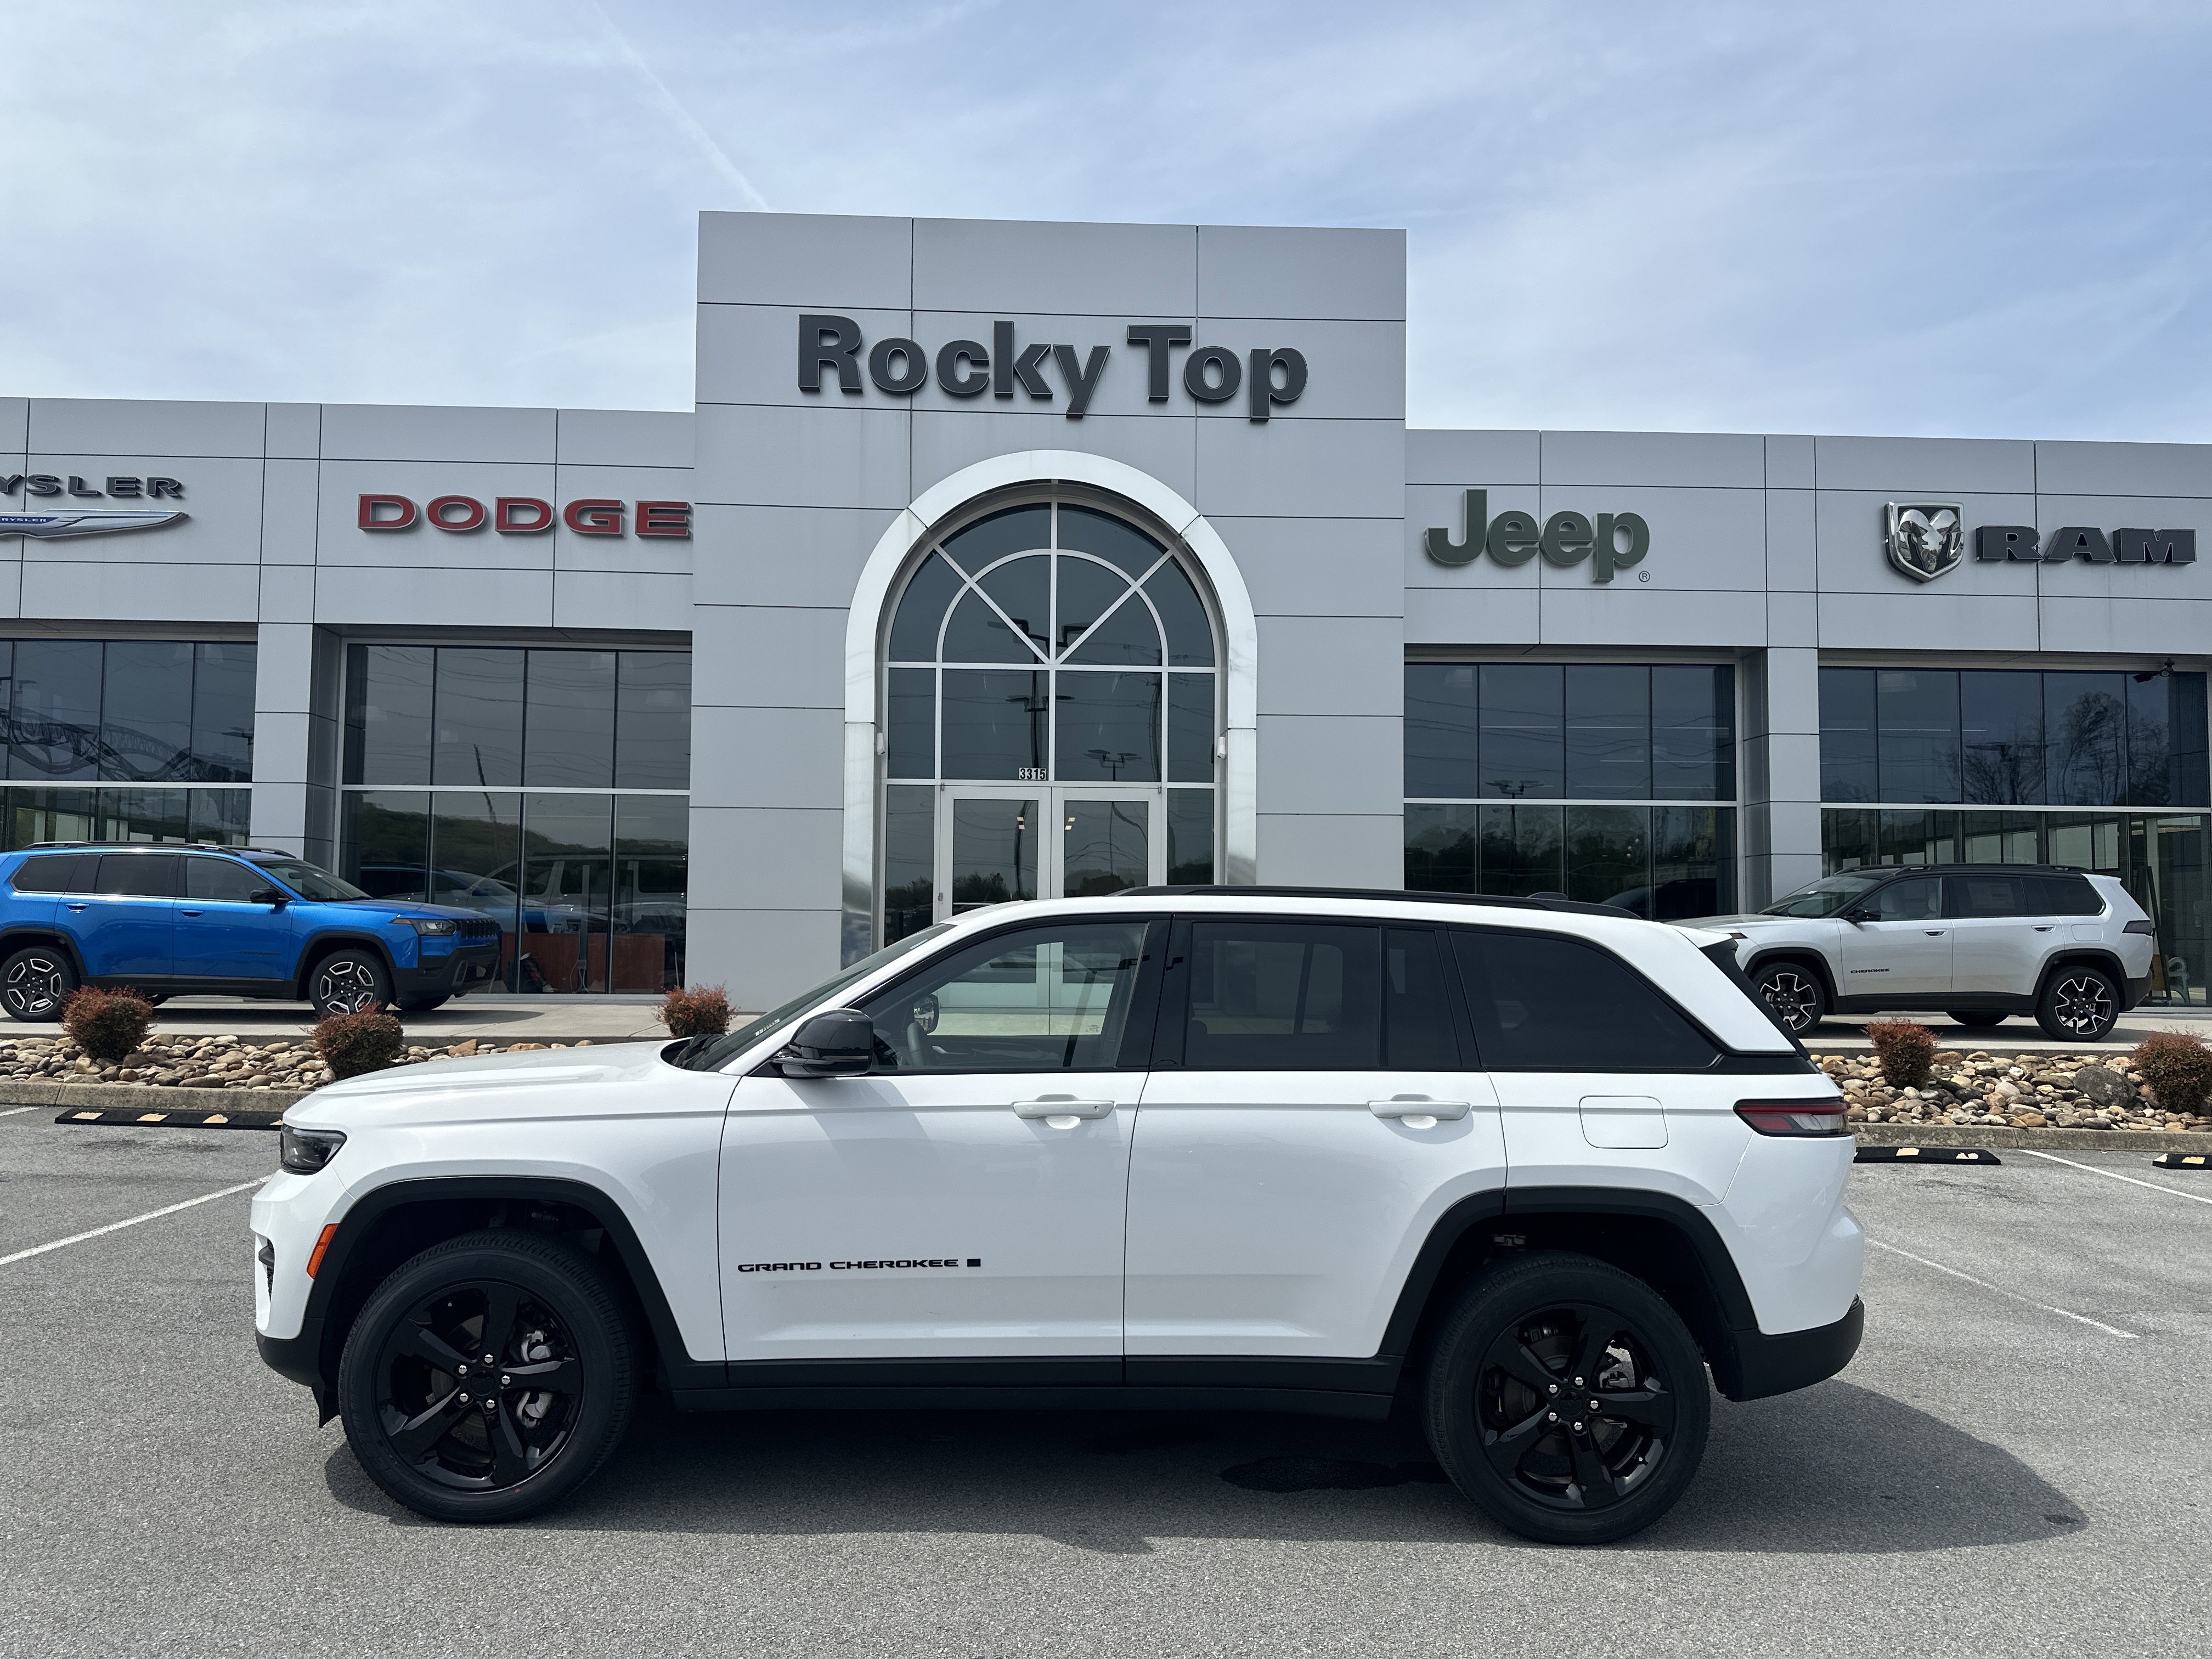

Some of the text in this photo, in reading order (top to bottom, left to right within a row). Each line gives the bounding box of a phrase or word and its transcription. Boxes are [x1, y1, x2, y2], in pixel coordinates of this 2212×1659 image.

[798, 314, 1308, 422] Rocky Top
[358, 494, 693, 539] DODGE
[1425, 489, 1650, 583] Jeep
[1976, 525, 2197, 566] RAM
[1020, 768, 1046, 780] 3315
[738, 1259, 959, 1272] GRAND CHEROKEE
